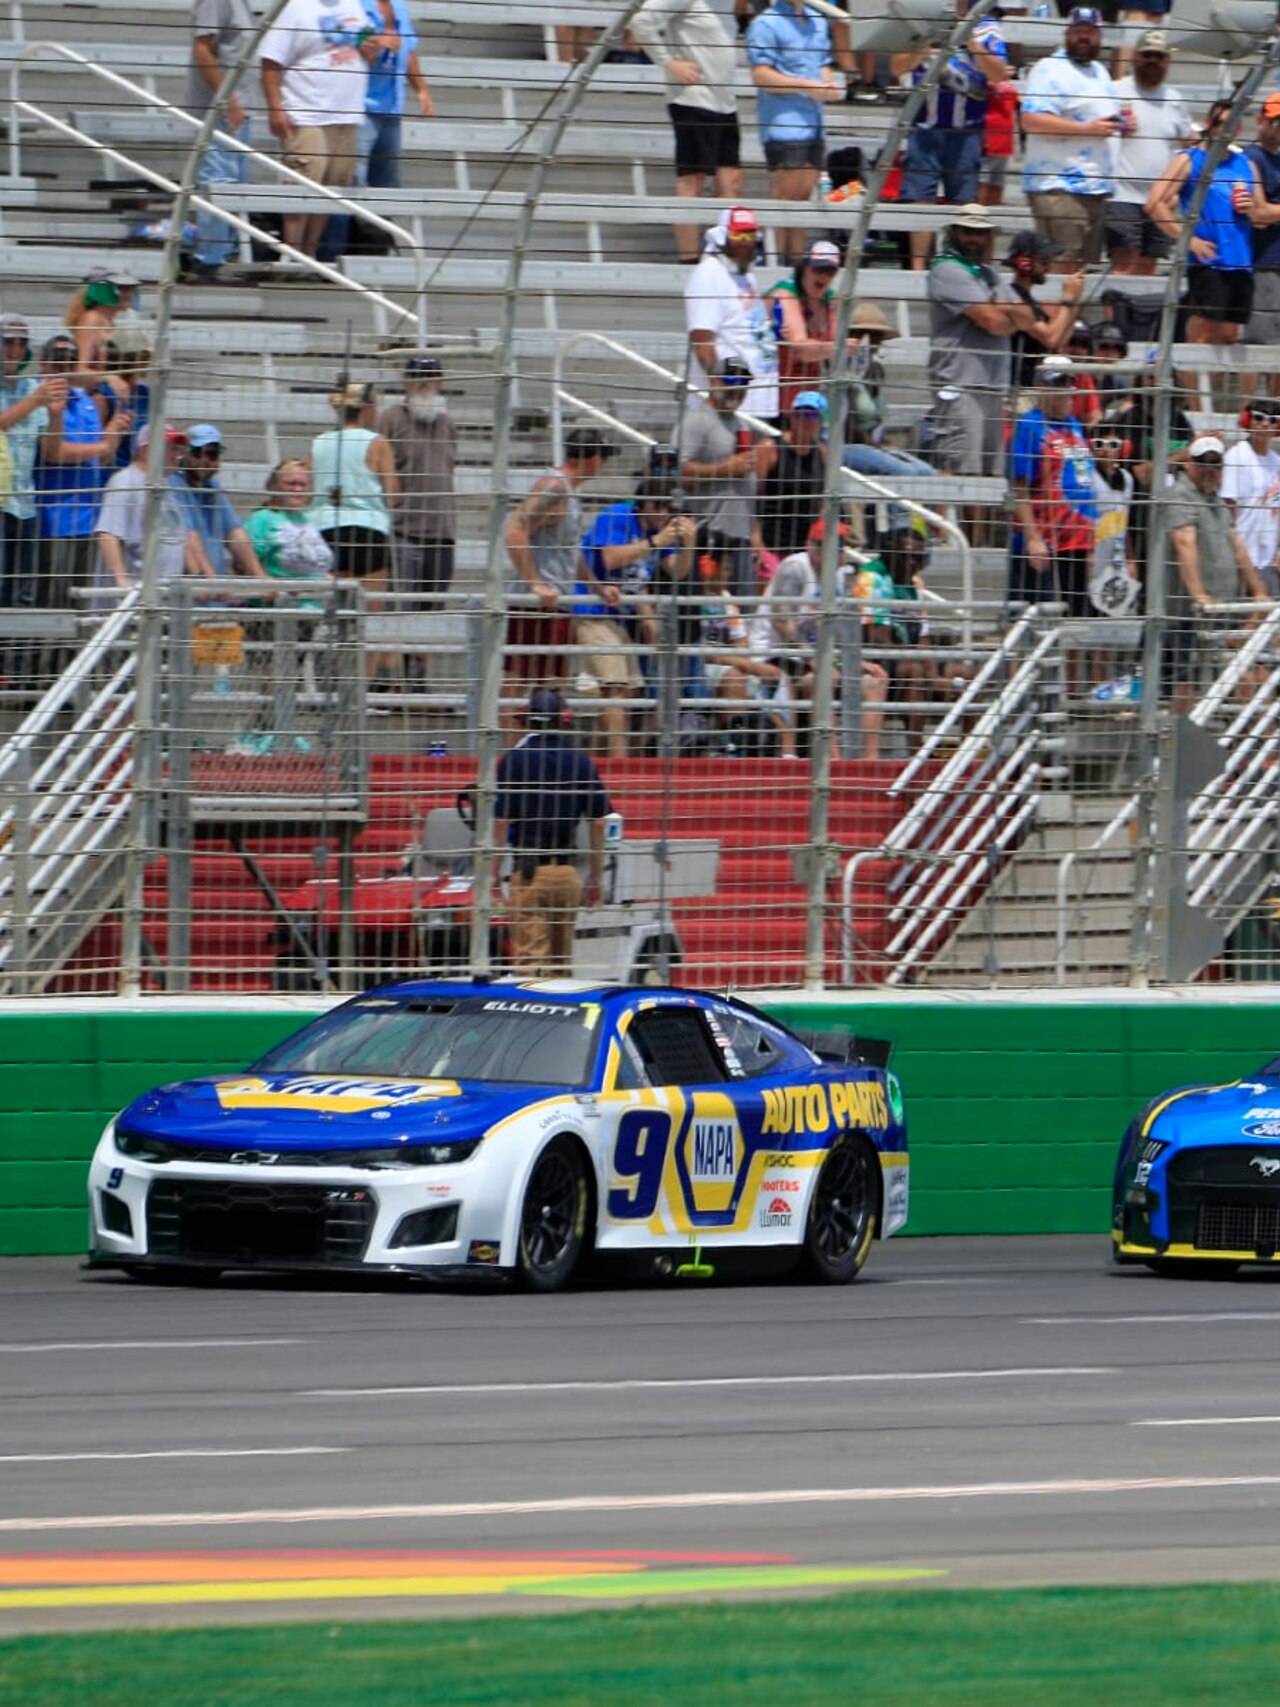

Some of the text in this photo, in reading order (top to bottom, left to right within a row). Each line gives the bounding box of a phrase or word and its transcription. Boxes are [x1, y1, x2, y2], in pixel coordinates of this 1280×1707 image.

[482, 1000, 579, 1017] ELLIOTT
[760, 1081, 888, 1135] AUTO PARTS
[608, 1108, 671, 1218] 9
[694, 1124, 734, 1176] NAPA
[106, 1167, 125, 1190] 9
